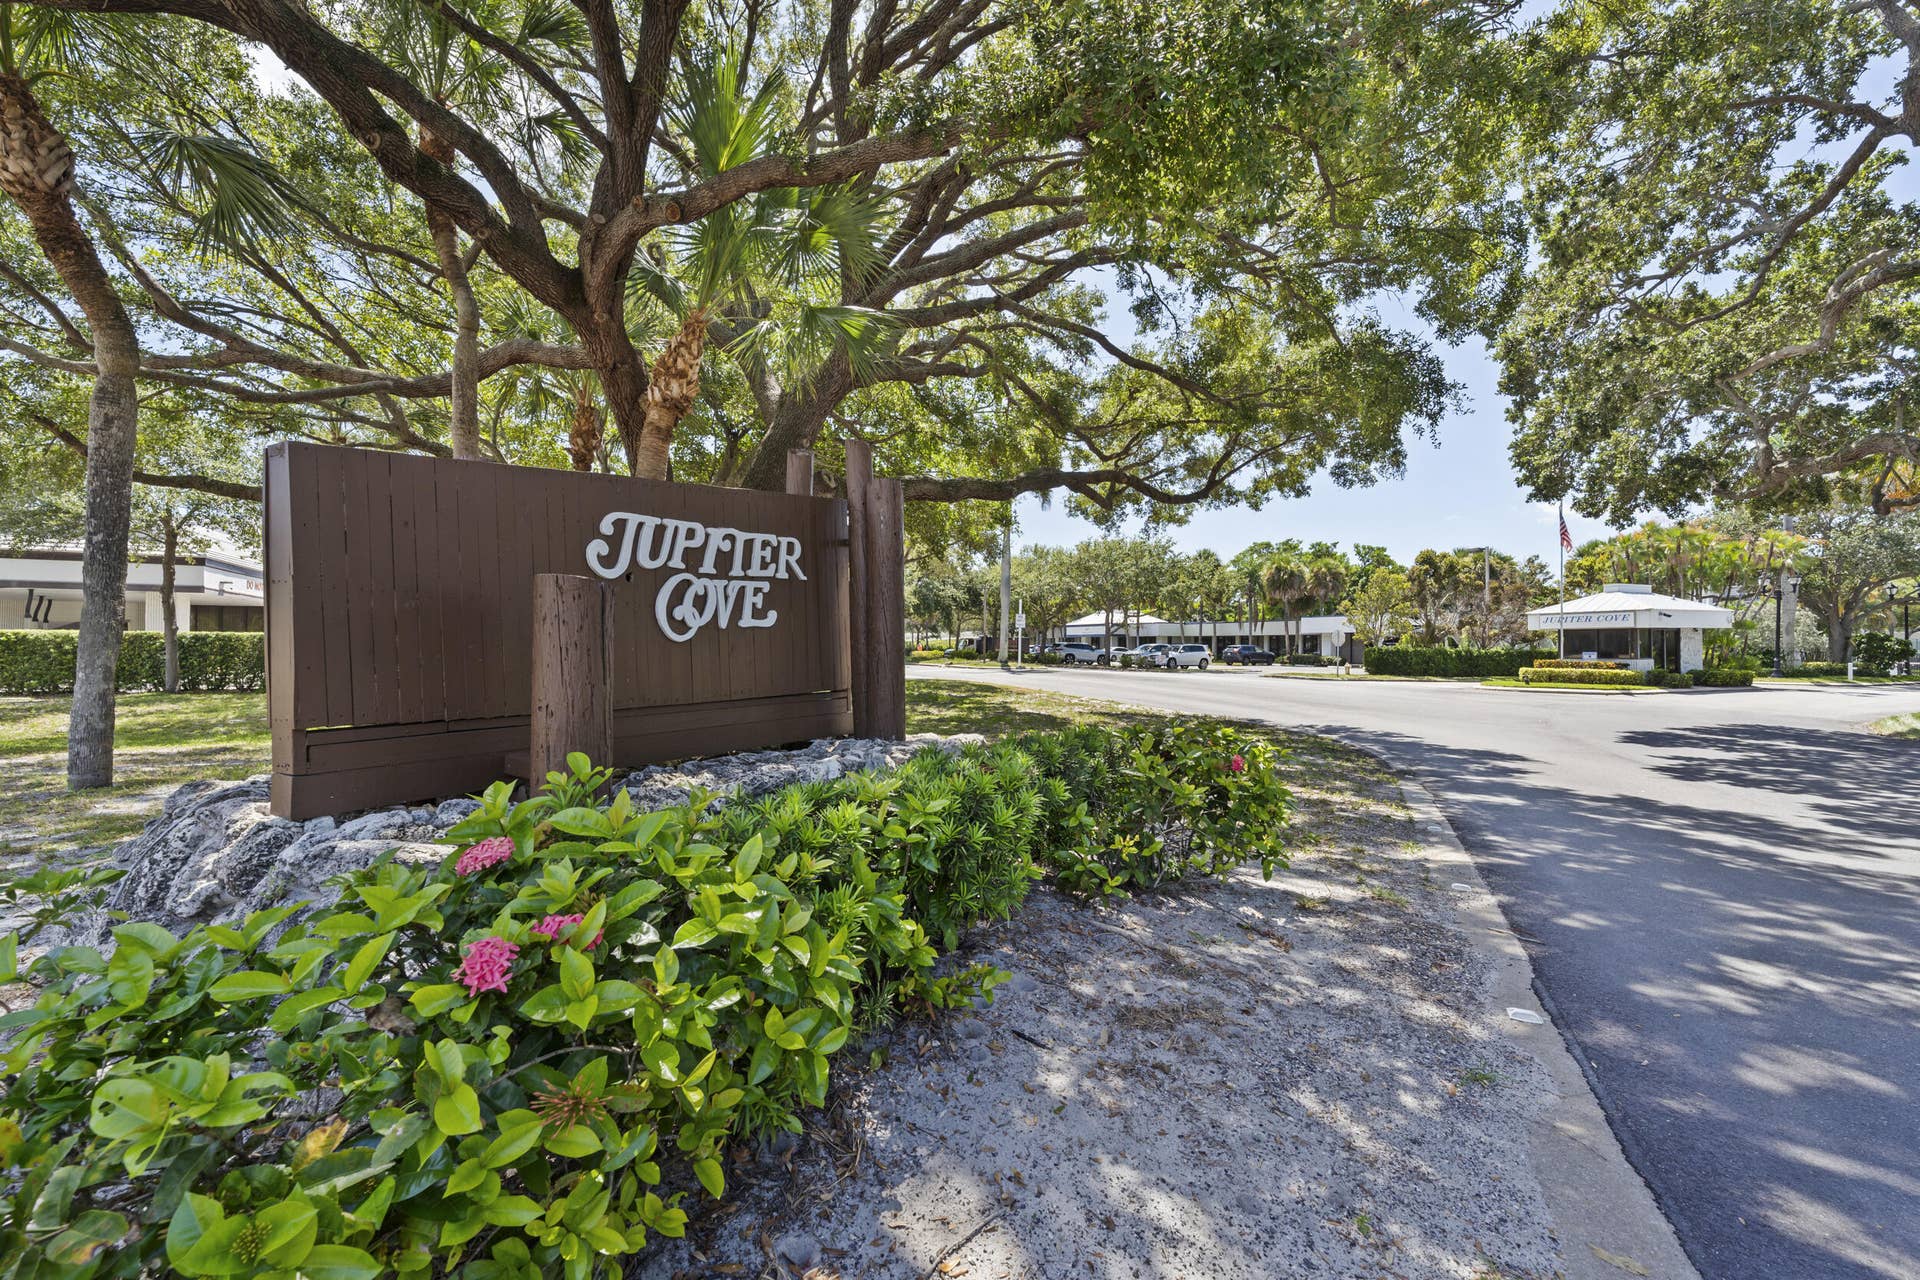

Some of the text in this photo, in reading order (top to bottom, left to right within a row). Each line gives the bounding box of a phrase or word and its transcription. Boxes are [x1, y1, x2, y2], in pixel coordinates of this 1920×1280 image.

[585, 511, 808, 579] JUPITER
[655, 572, 778, 643] COVE
[1596, 613, 1631, 622] COVE
